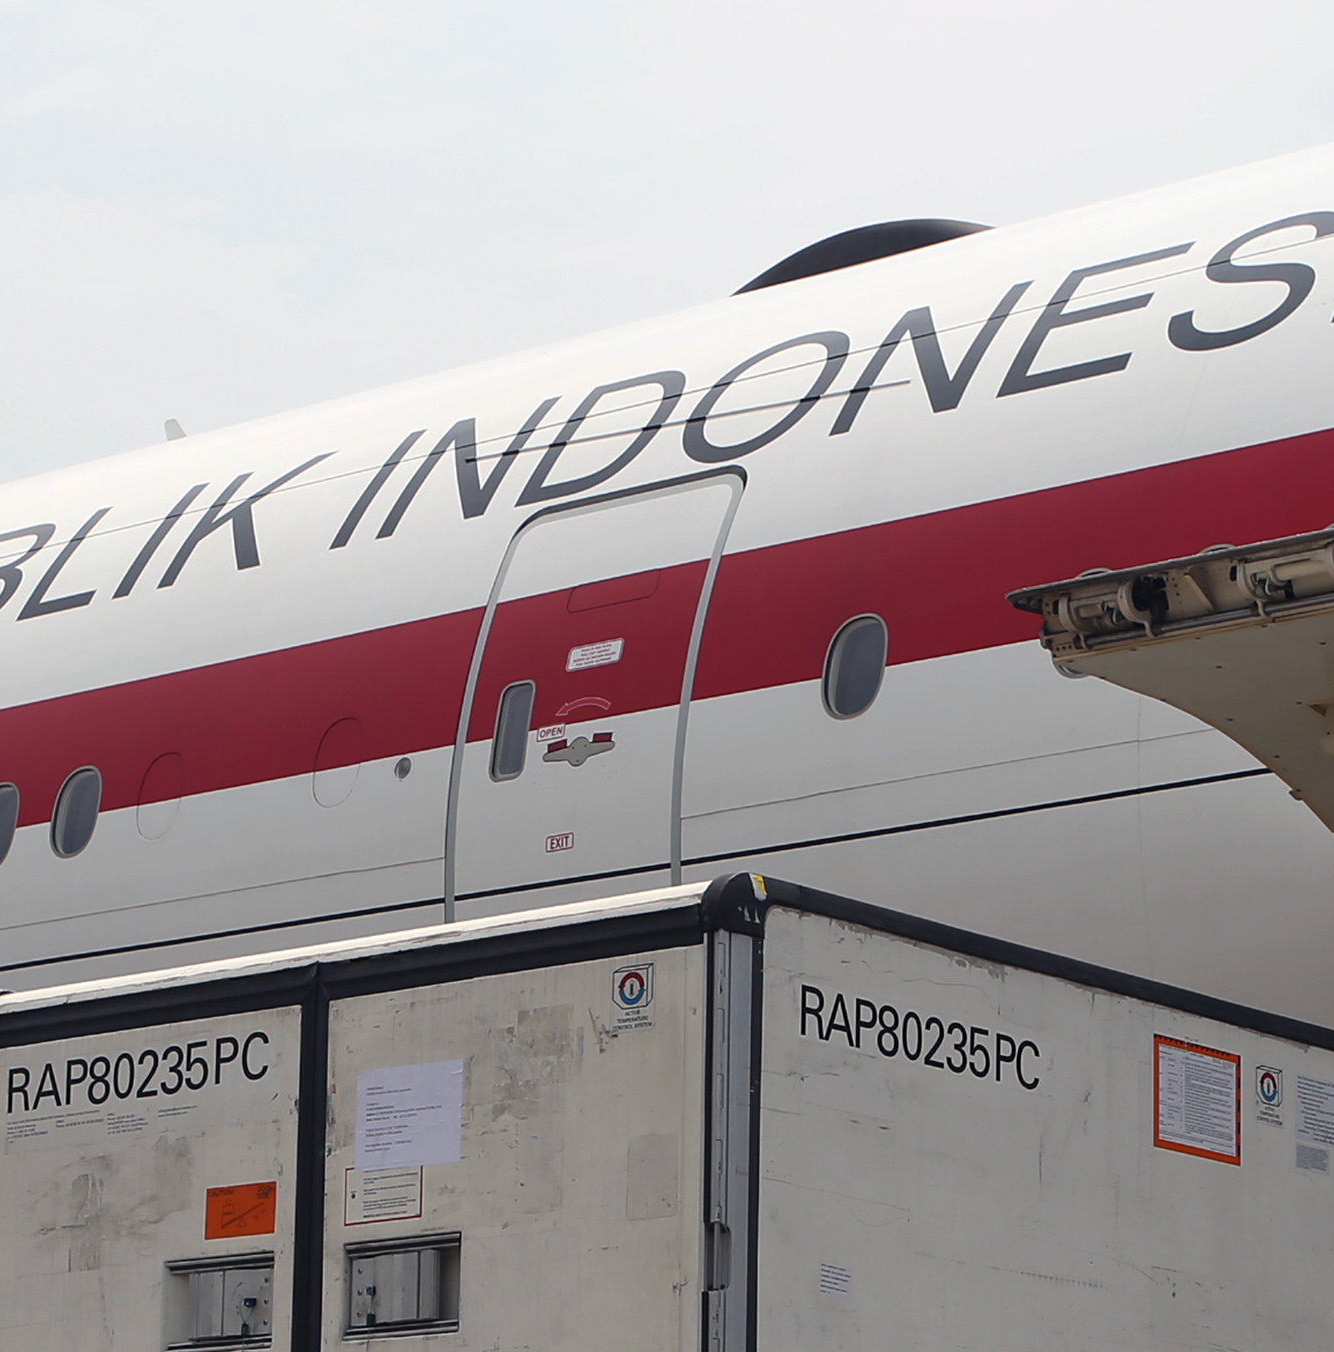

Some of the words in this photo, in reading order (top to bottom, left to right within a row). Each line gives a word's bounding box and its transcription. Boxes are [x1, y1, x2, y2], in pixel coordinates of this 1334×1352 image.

[539, 726, 563, 739] OPEN
[550, 835, 570, 850] EXIT
[799, 983, 1041, 1091] RAP80235PC
[6, 1029, 271, 1115] RAP80235PC
